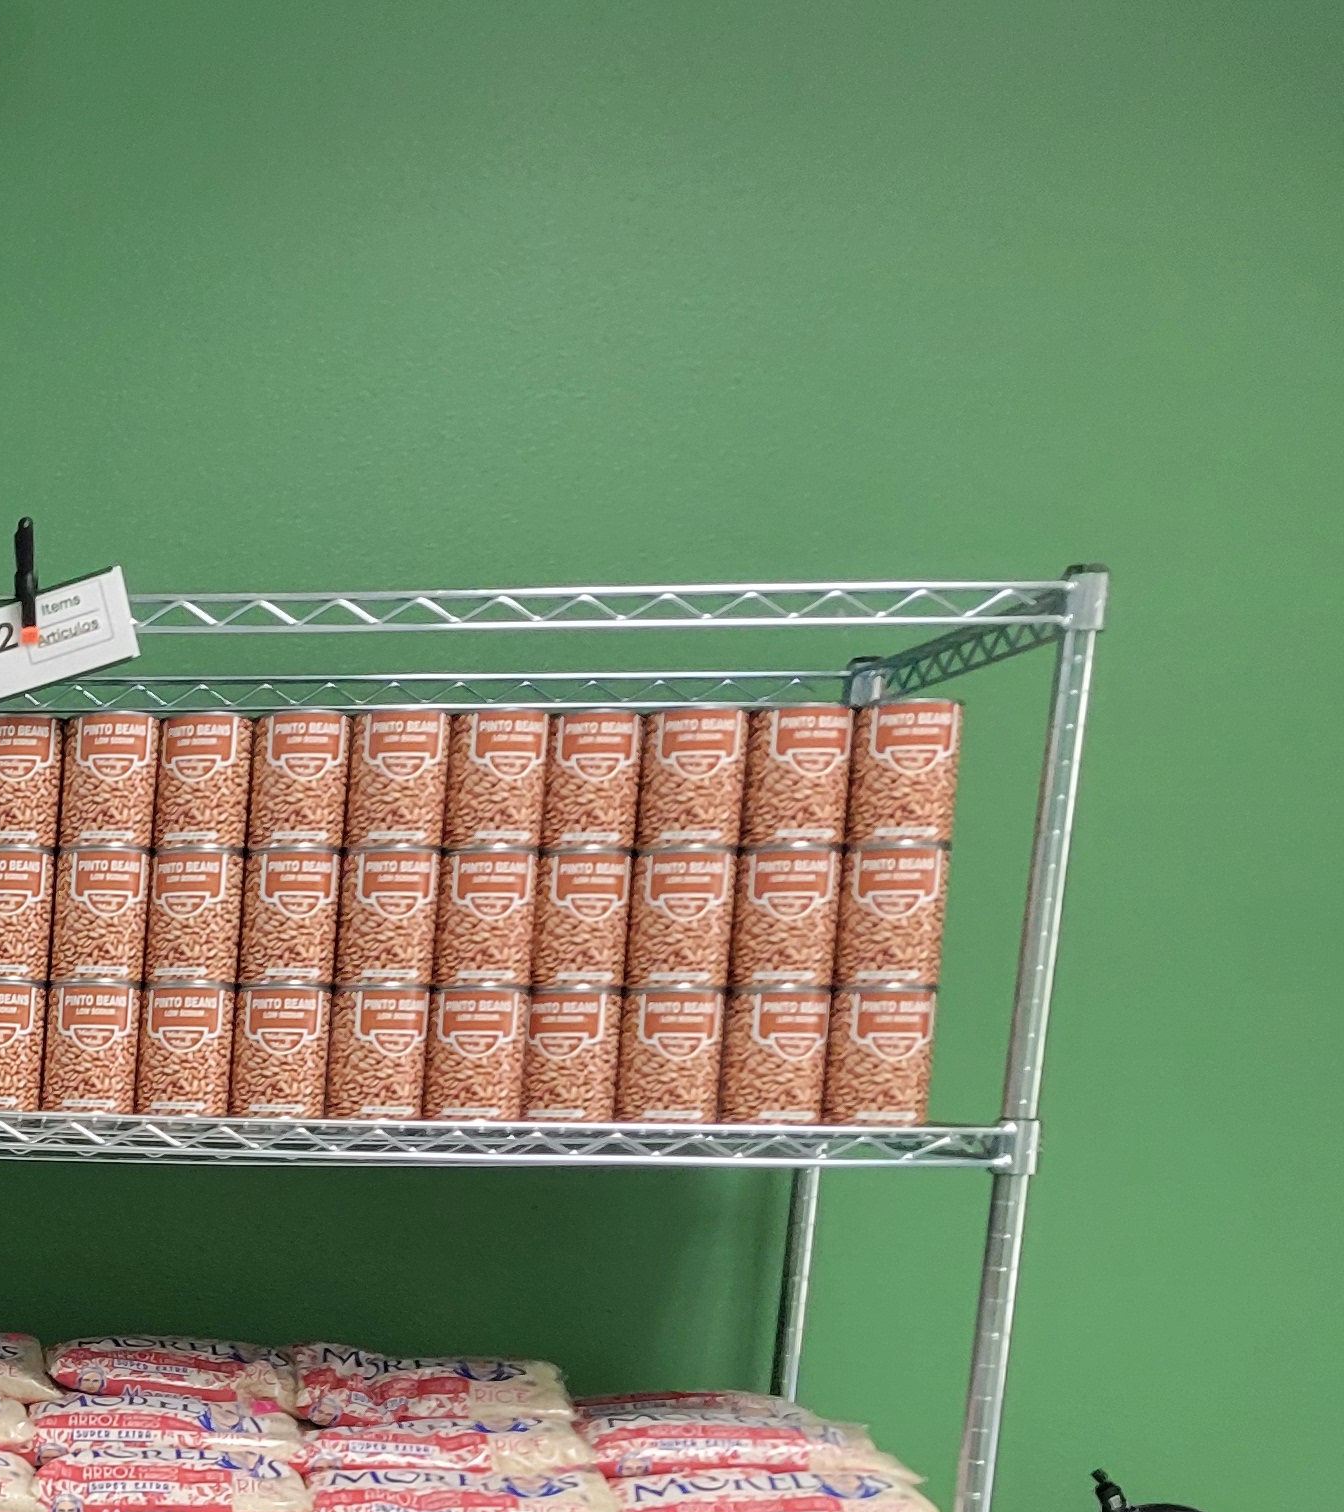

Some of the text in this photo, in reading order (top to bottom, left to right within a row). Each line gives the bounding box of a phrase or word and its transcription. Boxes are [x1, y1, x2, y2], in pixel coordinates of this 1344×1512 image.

[41, 594, 81, 617] Items
[154, 996, 217, 1009] PINTO BEANS
[83, 1465, 136, 1480] ARROZ
[634, 1473, 893, 1502] MORELS
